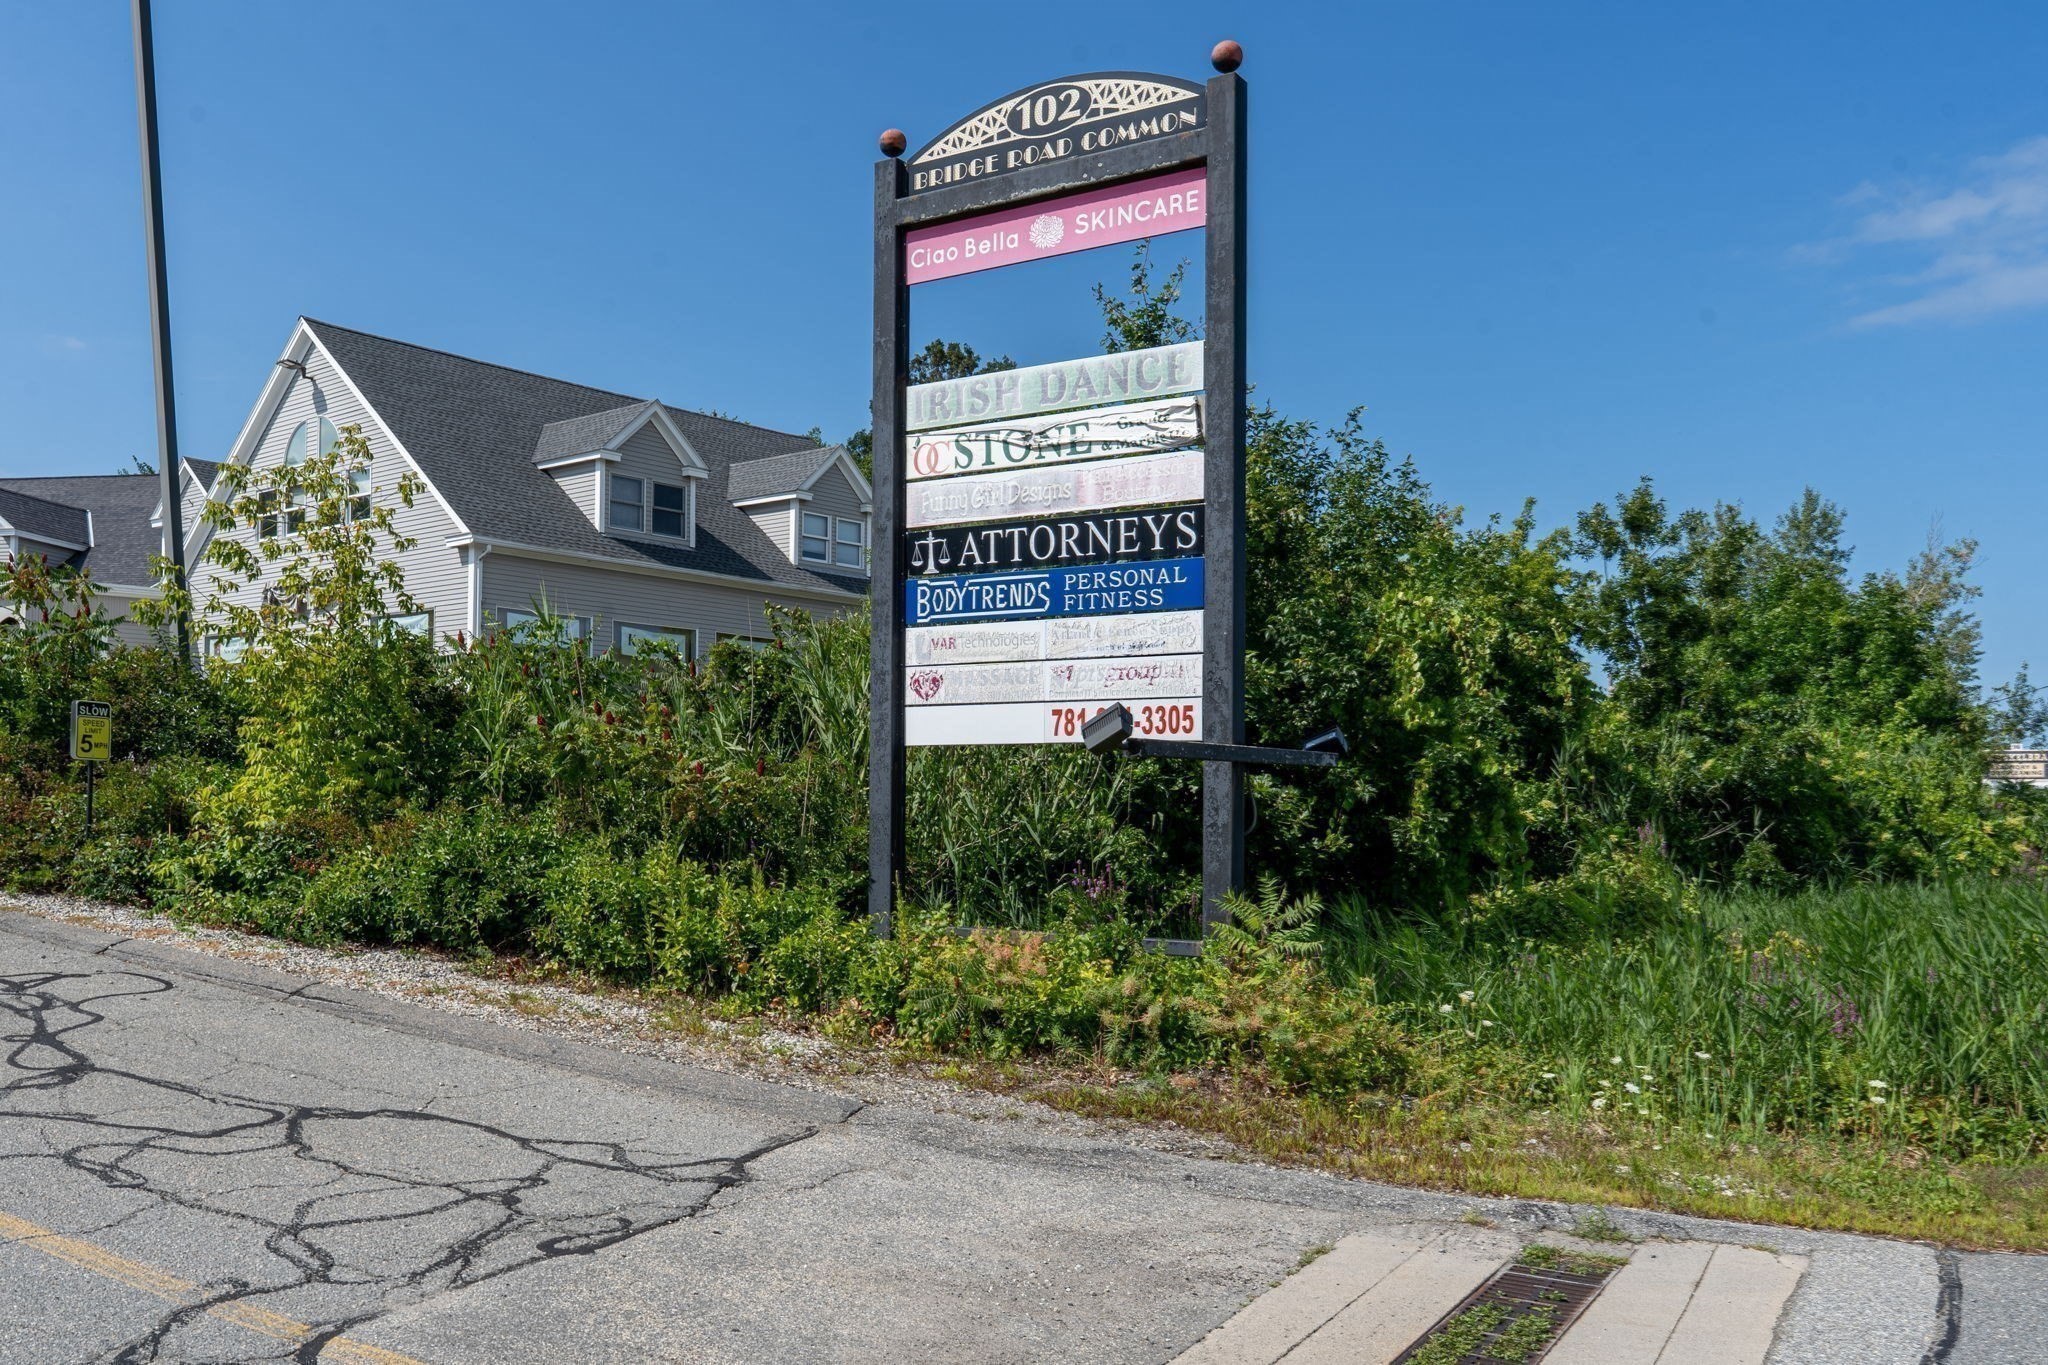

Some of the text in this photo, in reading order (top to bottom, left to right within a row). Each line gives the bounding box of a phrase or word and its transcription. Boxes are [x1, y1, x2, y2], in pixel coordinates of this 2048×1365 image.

[1016, 88, 1082, 131] 102
[913, 107, 1198, 191] BRIDGE ROAD COMMON
[1074, 189, 1199, 235] SKINCARE
[910, 231, 1019, 269] Ciao Bella
[914, 350, 1195, 426] IRISH DANCE
[954, 421, 1092, 470] STONE
[920, 491, 968, 516] Funny
[1008, 482, 1072, 508] Designs
[957, 511, 1198, 568] ATTORNEYS
[1063, 566, 1187, 591] PERSONAL
[1063, 588, 1164, 611] FITNESS
[930, 637, 957, 650] VAR
[79, 705, 108, 716] SLOW
[83, 719, 105, 728] SPEED
[80, 734, 93, 753] 5
